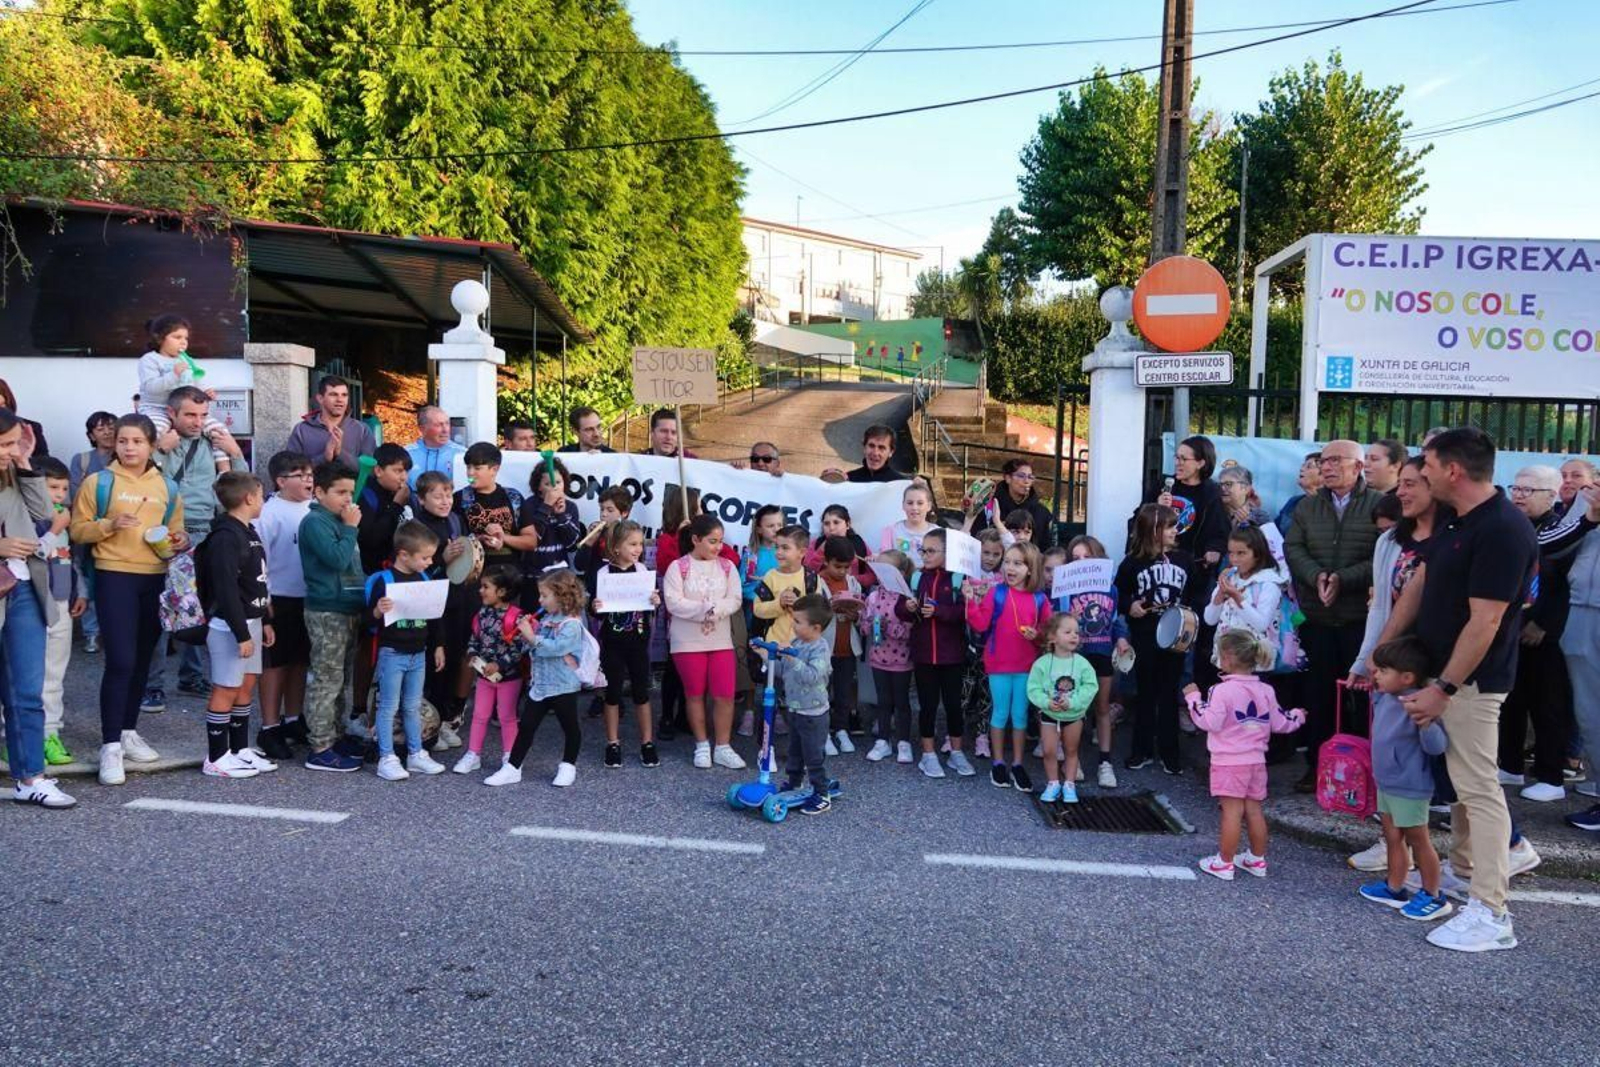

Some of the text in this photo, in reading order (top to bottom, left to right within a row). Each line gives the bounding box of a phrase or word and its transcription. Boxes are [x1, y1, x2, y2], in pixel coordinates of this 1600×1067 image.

[1333, 242, 1444, 269] C.E.I.P
[1374, 290, 1455, 314] NOSO
[1462, 292, 1545, 320] COLE,
[1438, 326, 1459, 349] O
[1467, 327, 1546, 351] VOSO
[1141, 357, 1225, 369] EXCEPTO SERVIZOS
[1360, 359, 1470, 372] XUNTA DE GALICIA
[1144, 371, 1221, 382] CENTRO ESCOLAR
[1412, 373, 1422, 381] DE
[650, 378, 694, 399] TITOR
